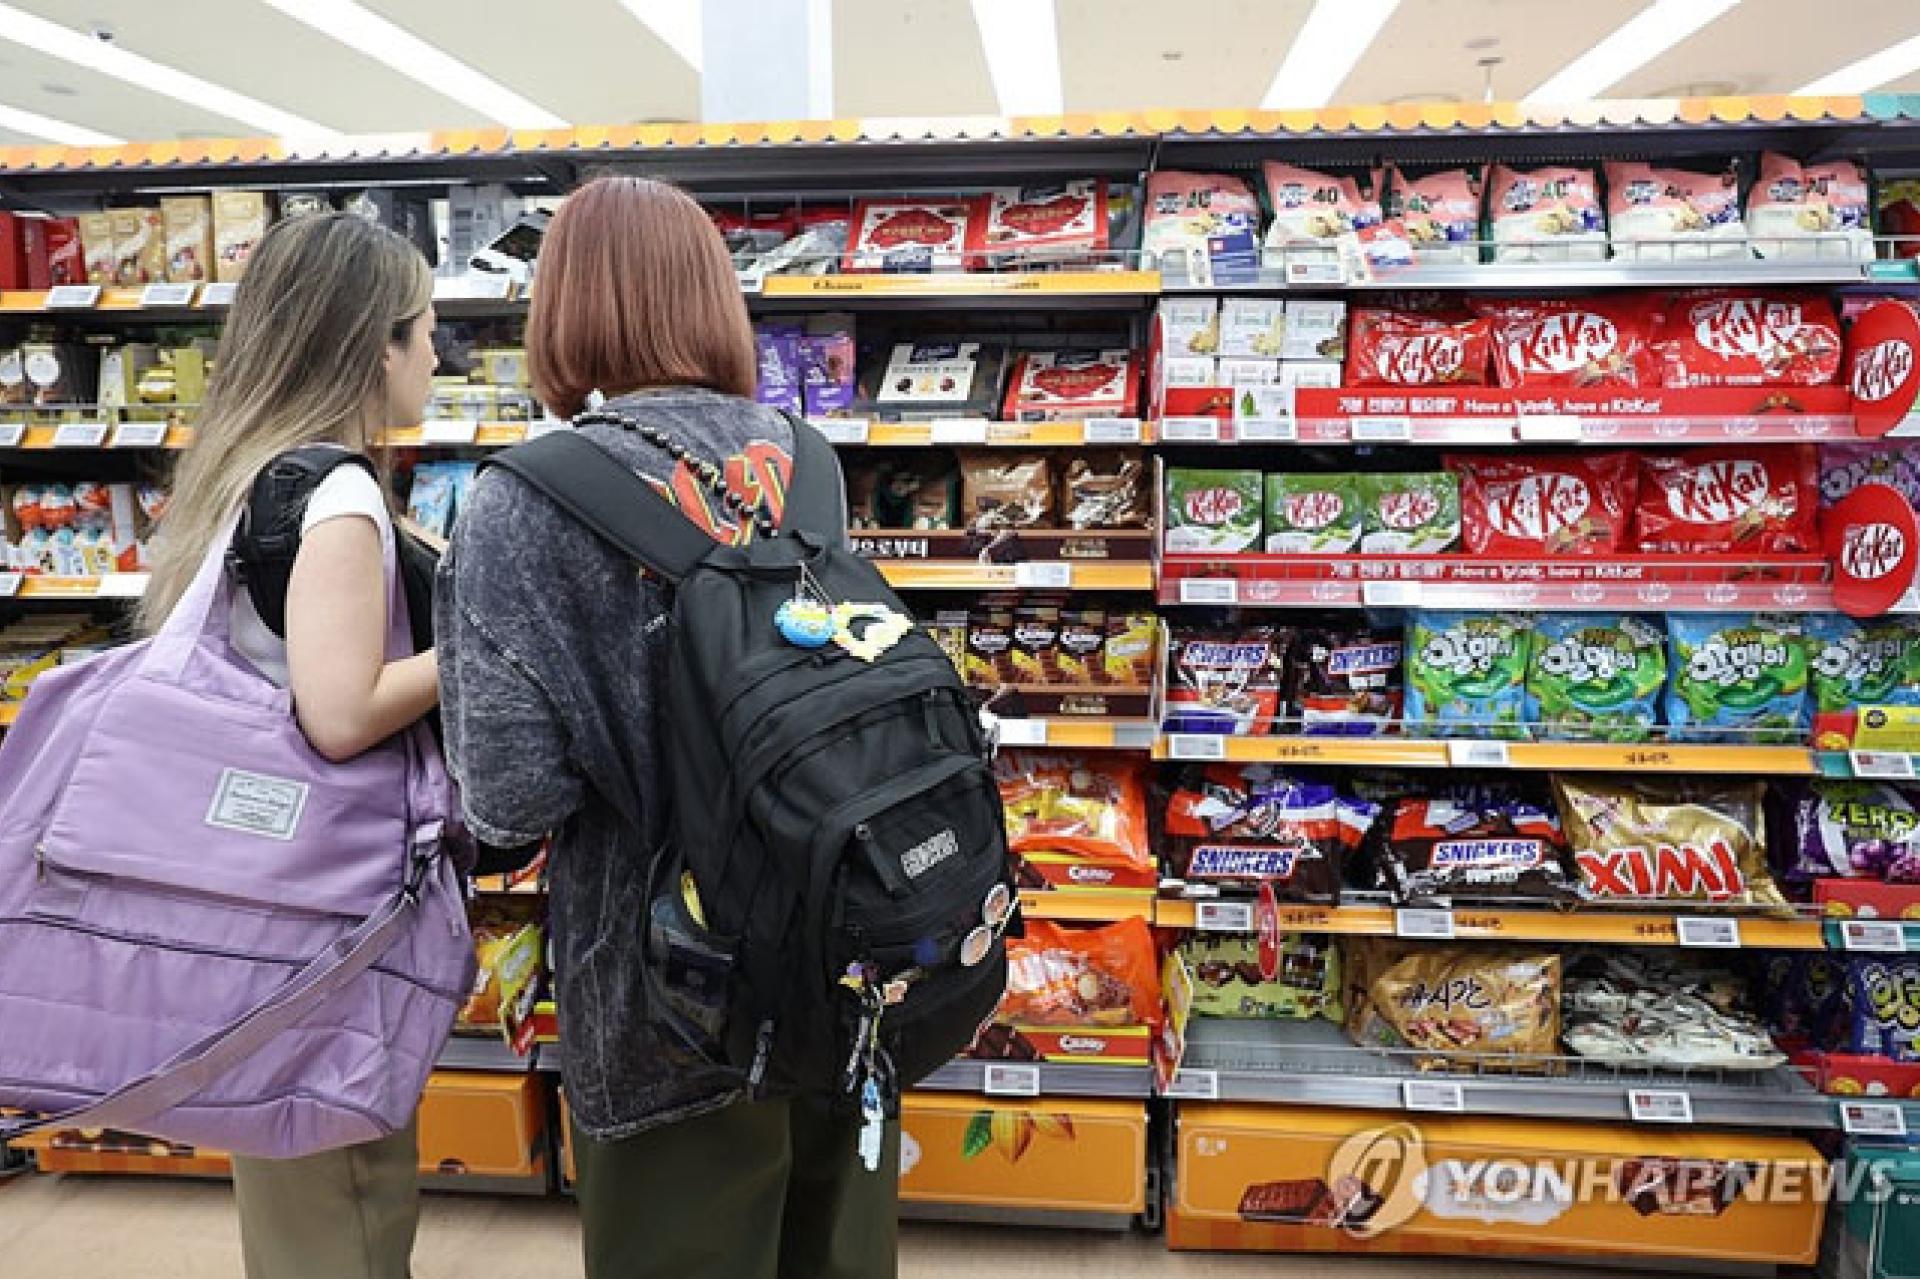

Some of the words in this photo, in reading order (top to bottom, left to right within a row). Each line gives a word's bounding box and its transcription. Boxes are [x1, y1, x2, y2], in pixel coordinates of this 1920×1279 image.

[1508, 313, 1617, 373] KitKat
[1702, 300, 1804, 356] KitKat
[1386, 334, 1463, 382] KitKat
[1857, 341, 1912, 400] KitKat
[1464, 397, 1499, 413] Have
[1563, 397, 1596, 413] have
[1494, 476, 1590, 536] KitKat
[1676, 462, 1768, 522] KitKat
[1452, 563, 1486, 579] Have
[1548, 563, 1579, 579] have
[1844, 526, 1903, 577] KitKat
[1191, 848, 1295, 876] SNICKERS
[1435, 840, 1538, 863] SNICKERS
